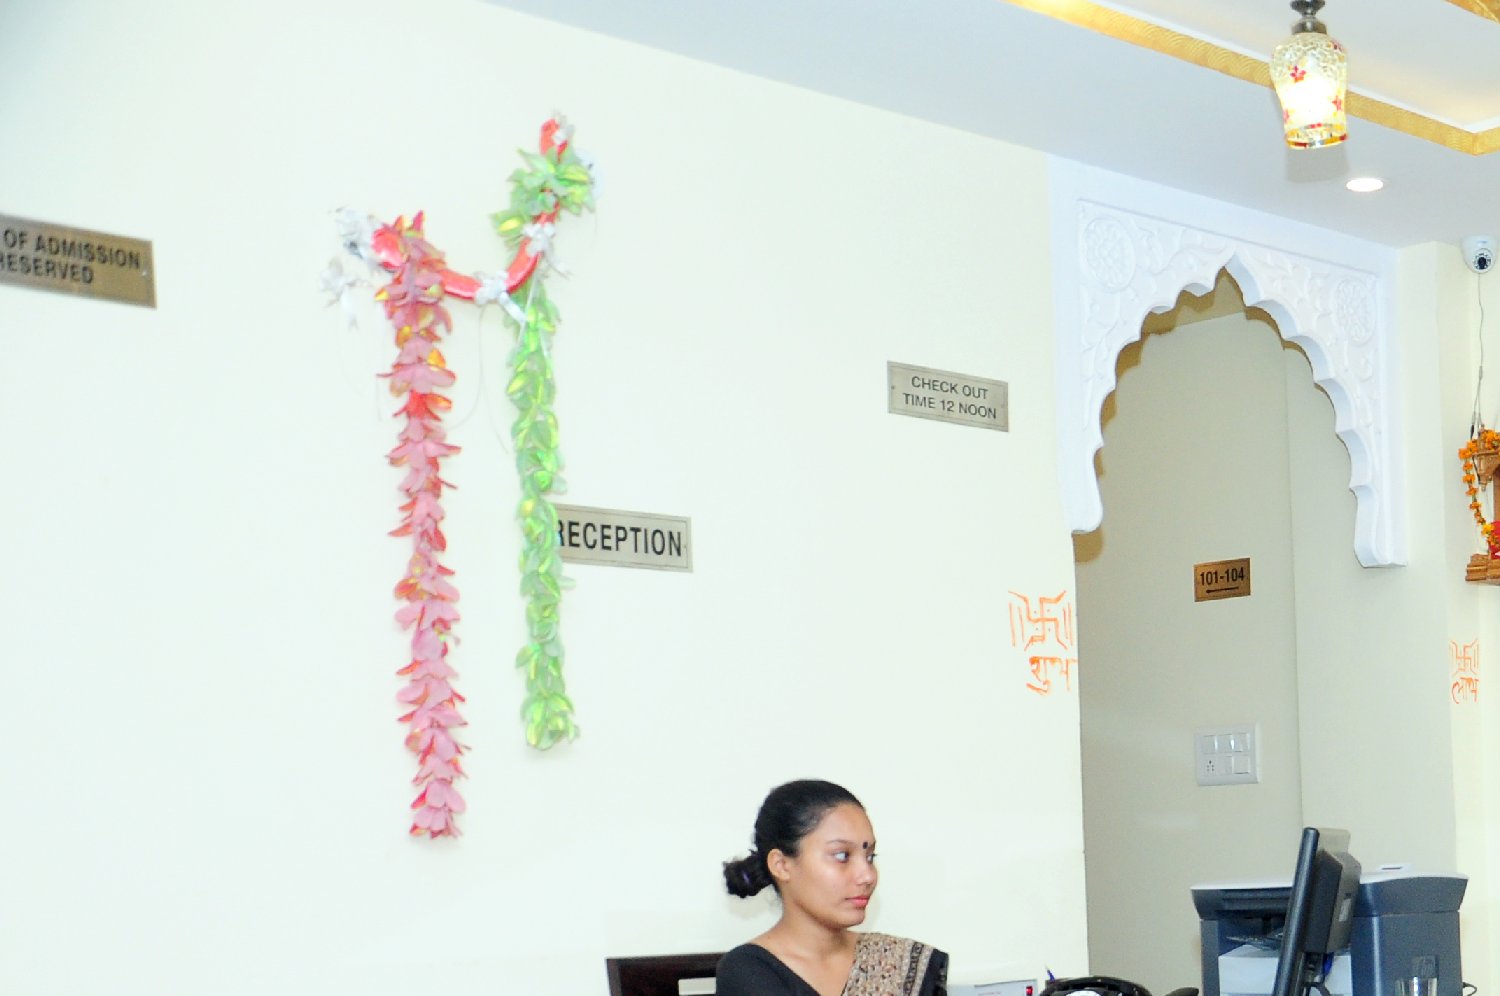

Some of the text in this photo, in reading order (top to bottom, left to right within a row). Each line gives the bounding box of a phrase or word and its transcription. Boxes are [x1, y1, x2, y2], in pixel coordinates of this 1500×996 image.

[3, 228, 141, 270] OF ADMISSION
[911, 375, 989, 400] CHECK OUT
[903, 392, 997, 420] TIME 12 NOON
[1200, 566, 1245, 586] 101-104
